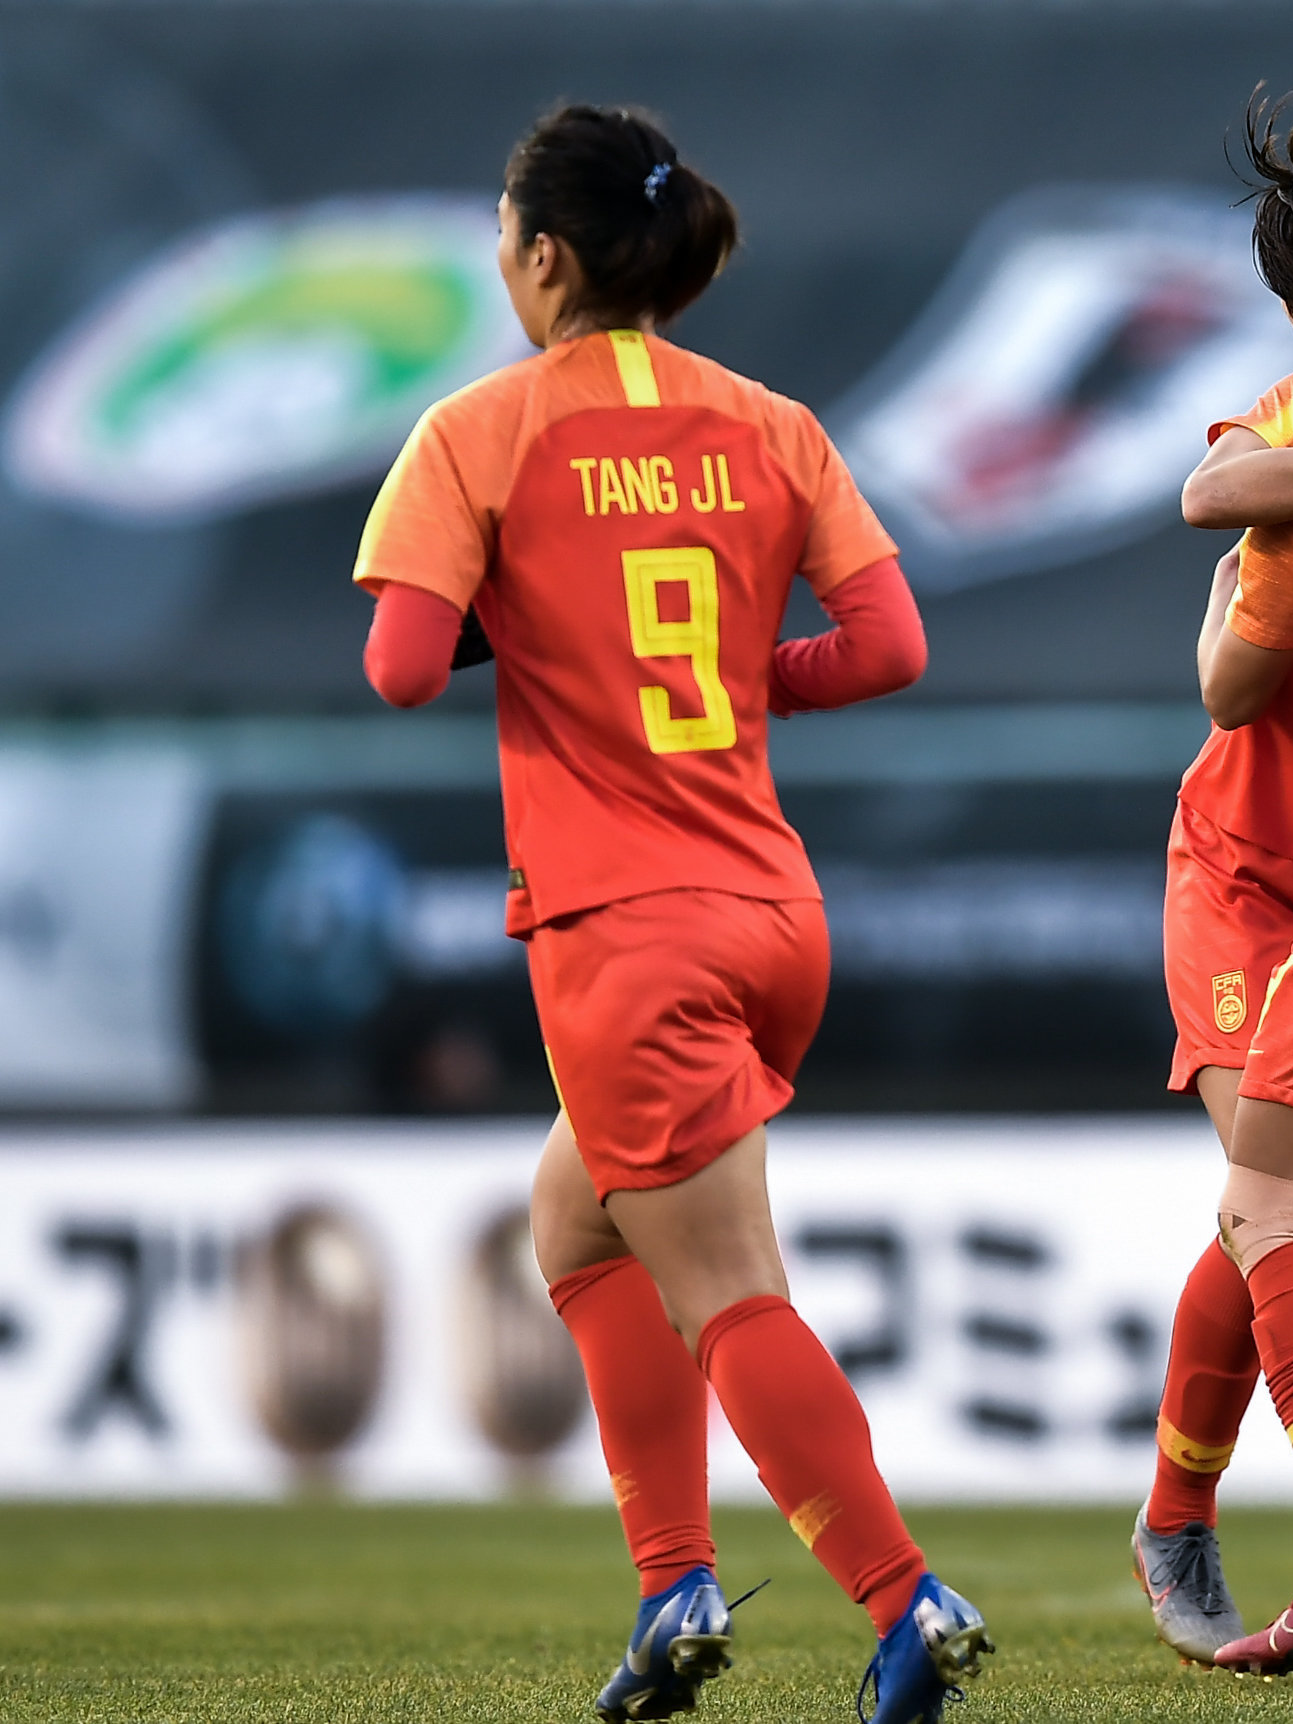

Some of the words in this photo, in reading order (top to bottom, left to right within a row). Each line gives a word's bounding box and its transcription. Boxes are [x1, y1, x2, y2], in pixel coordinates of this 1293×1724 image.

[570, 456, 679, 516] TANG
[690, 453, 745, 513] JL
[620, 546, 738, 755] 9
[1215, 974, 1242, 990] CFA
